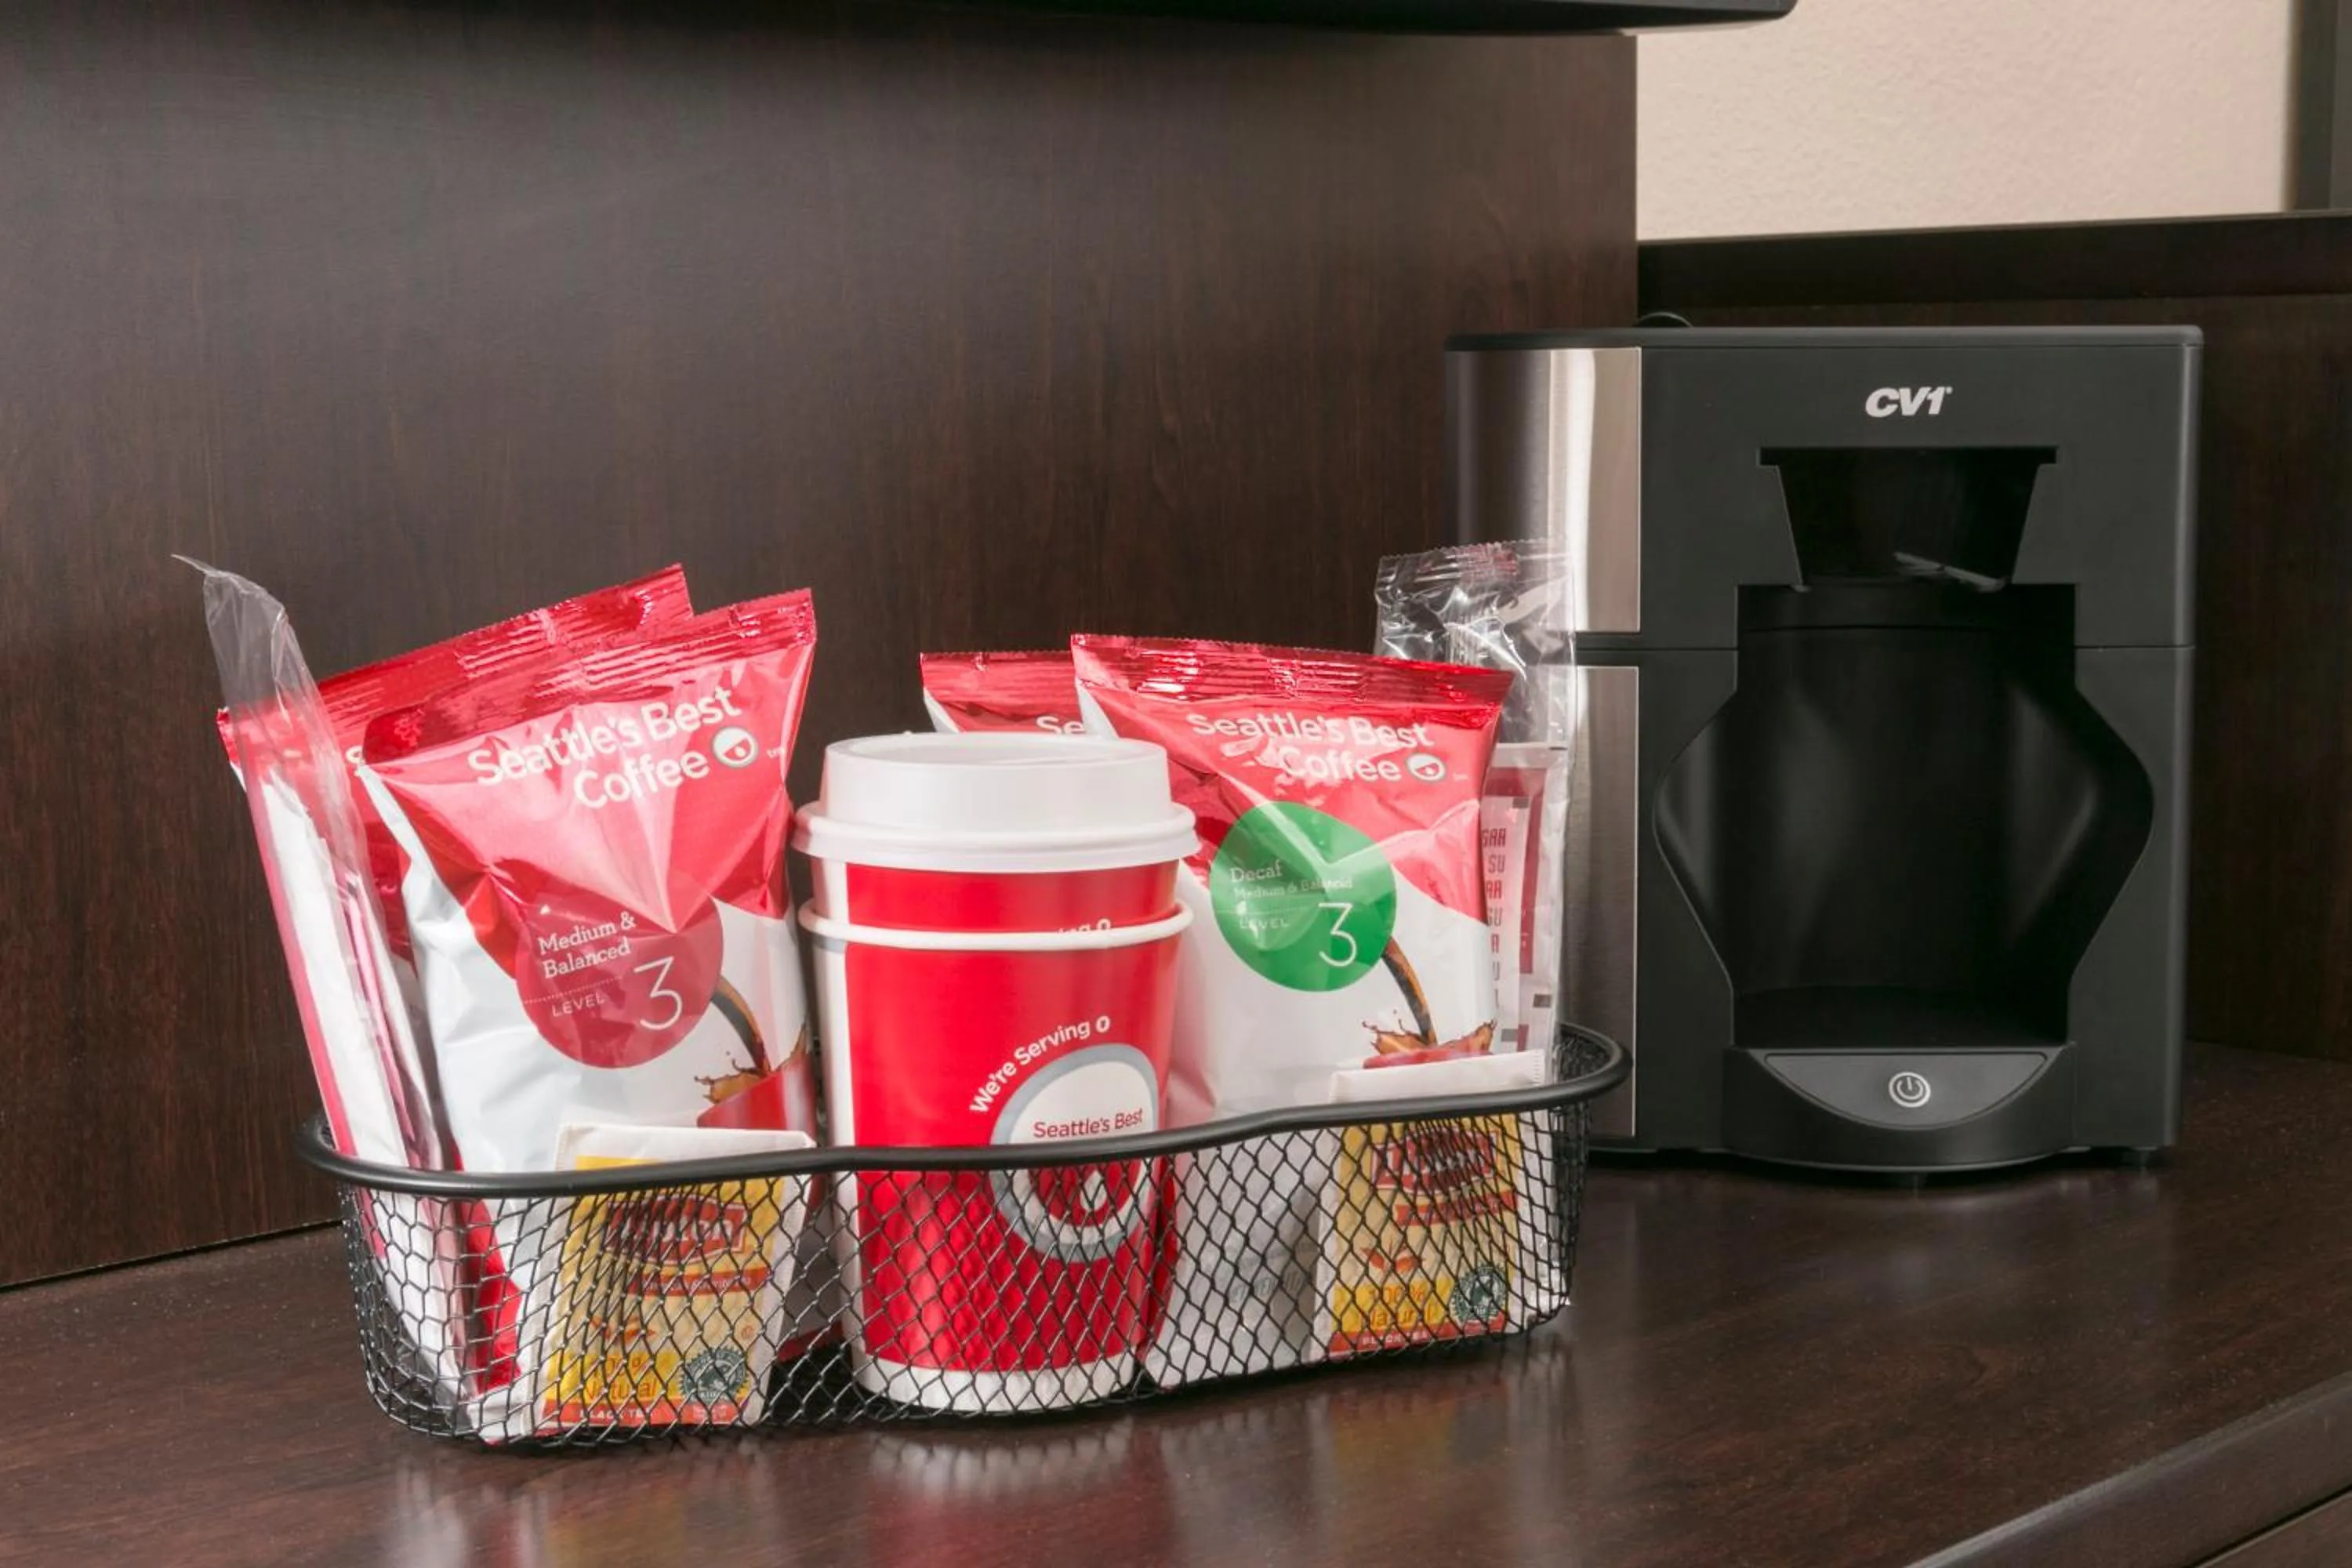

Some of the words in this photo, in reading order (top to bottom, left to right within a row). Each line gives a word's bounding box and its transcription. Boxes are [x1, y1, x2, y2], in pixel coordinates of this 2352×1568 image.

[468, 716, 643, 786] Seattle's
[641, 685, 743, 742] Best
[1186, 712, 1346, 746] Seattle's
[1348, 715, 1435, 749] Best
[573, 750, 710, 808] Coffee
[1280, 746, 1402, 781] Coffee
[1230, 859, 1283, 883] Decaf
[538, 920, 617, 956] Medium
[619, 910, 637, 931] &
[1318, 902, 1358, 967] 3
[541, 935, 632, 979] Balanced
[551, 991, 606, 1018] LEVEL
[633, 956, 683, 1031] 3
[969, 1060, 1018, 1114] We're
[1014, 1019, 1091, 1066] Serving
[1033, 1116, 1110, 1139] Seattle's
[1114, 1107, 1143, 1131] Best
